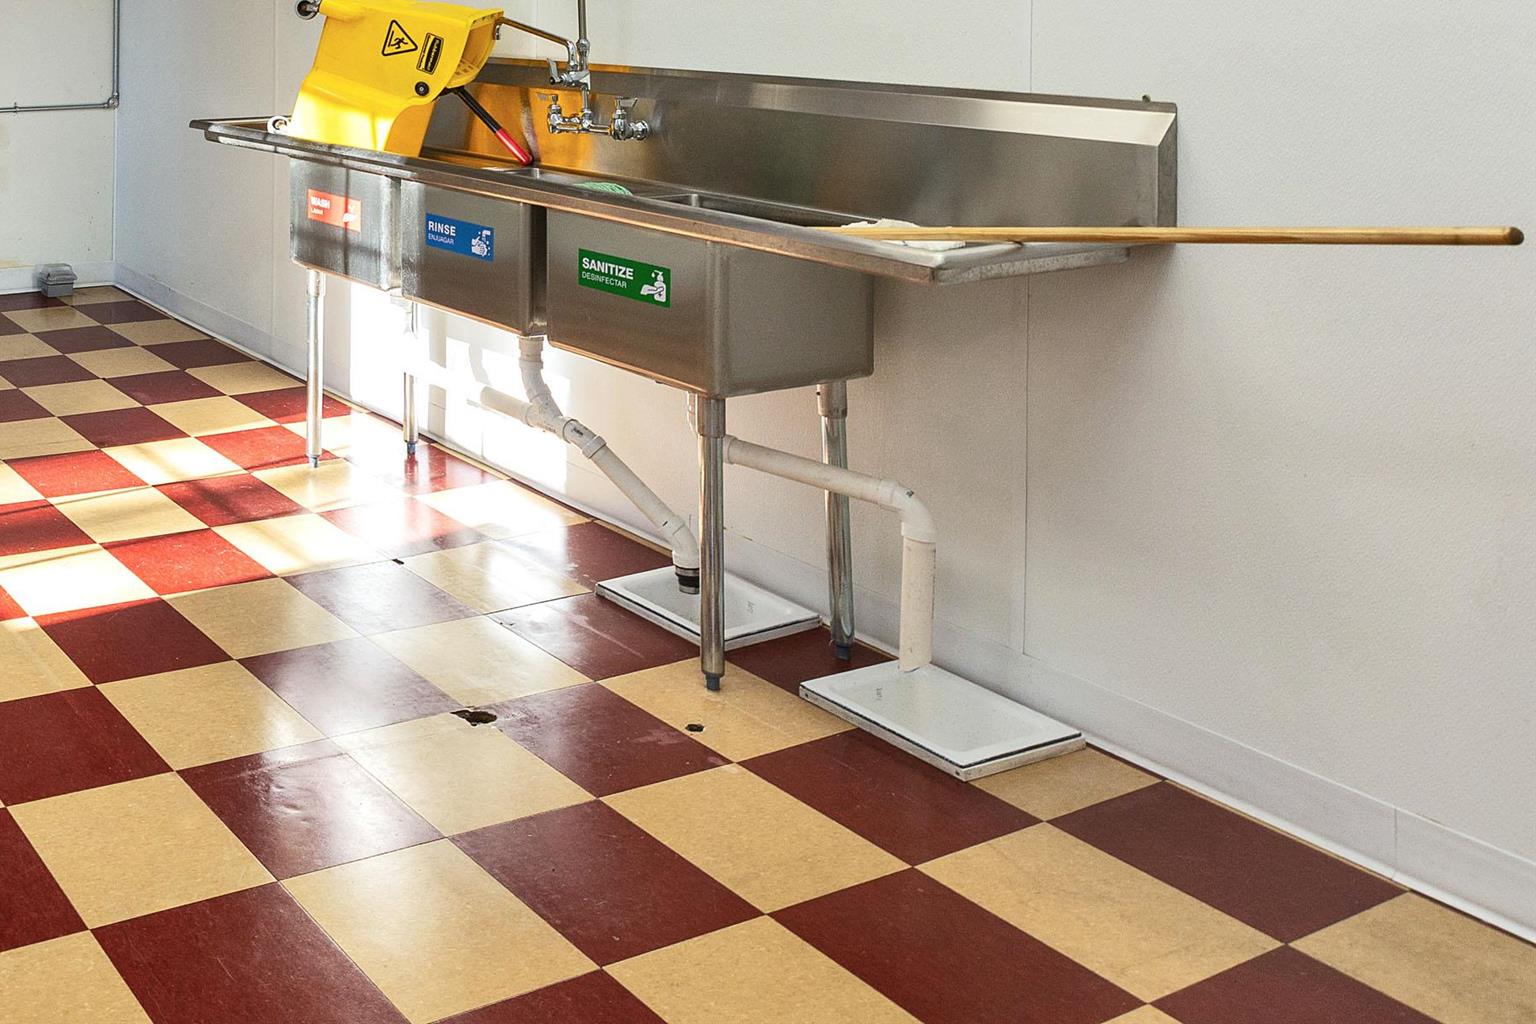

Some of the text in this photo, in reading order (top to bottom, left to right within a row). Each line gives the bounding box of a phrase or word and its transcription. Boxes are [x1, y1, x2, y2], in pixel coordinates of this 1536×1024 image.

[428, 220, 456, 236] RINSE
[582, 257, 634, 280] SANITIZE
[581, 271, 627, 289] DESINFECTAR
